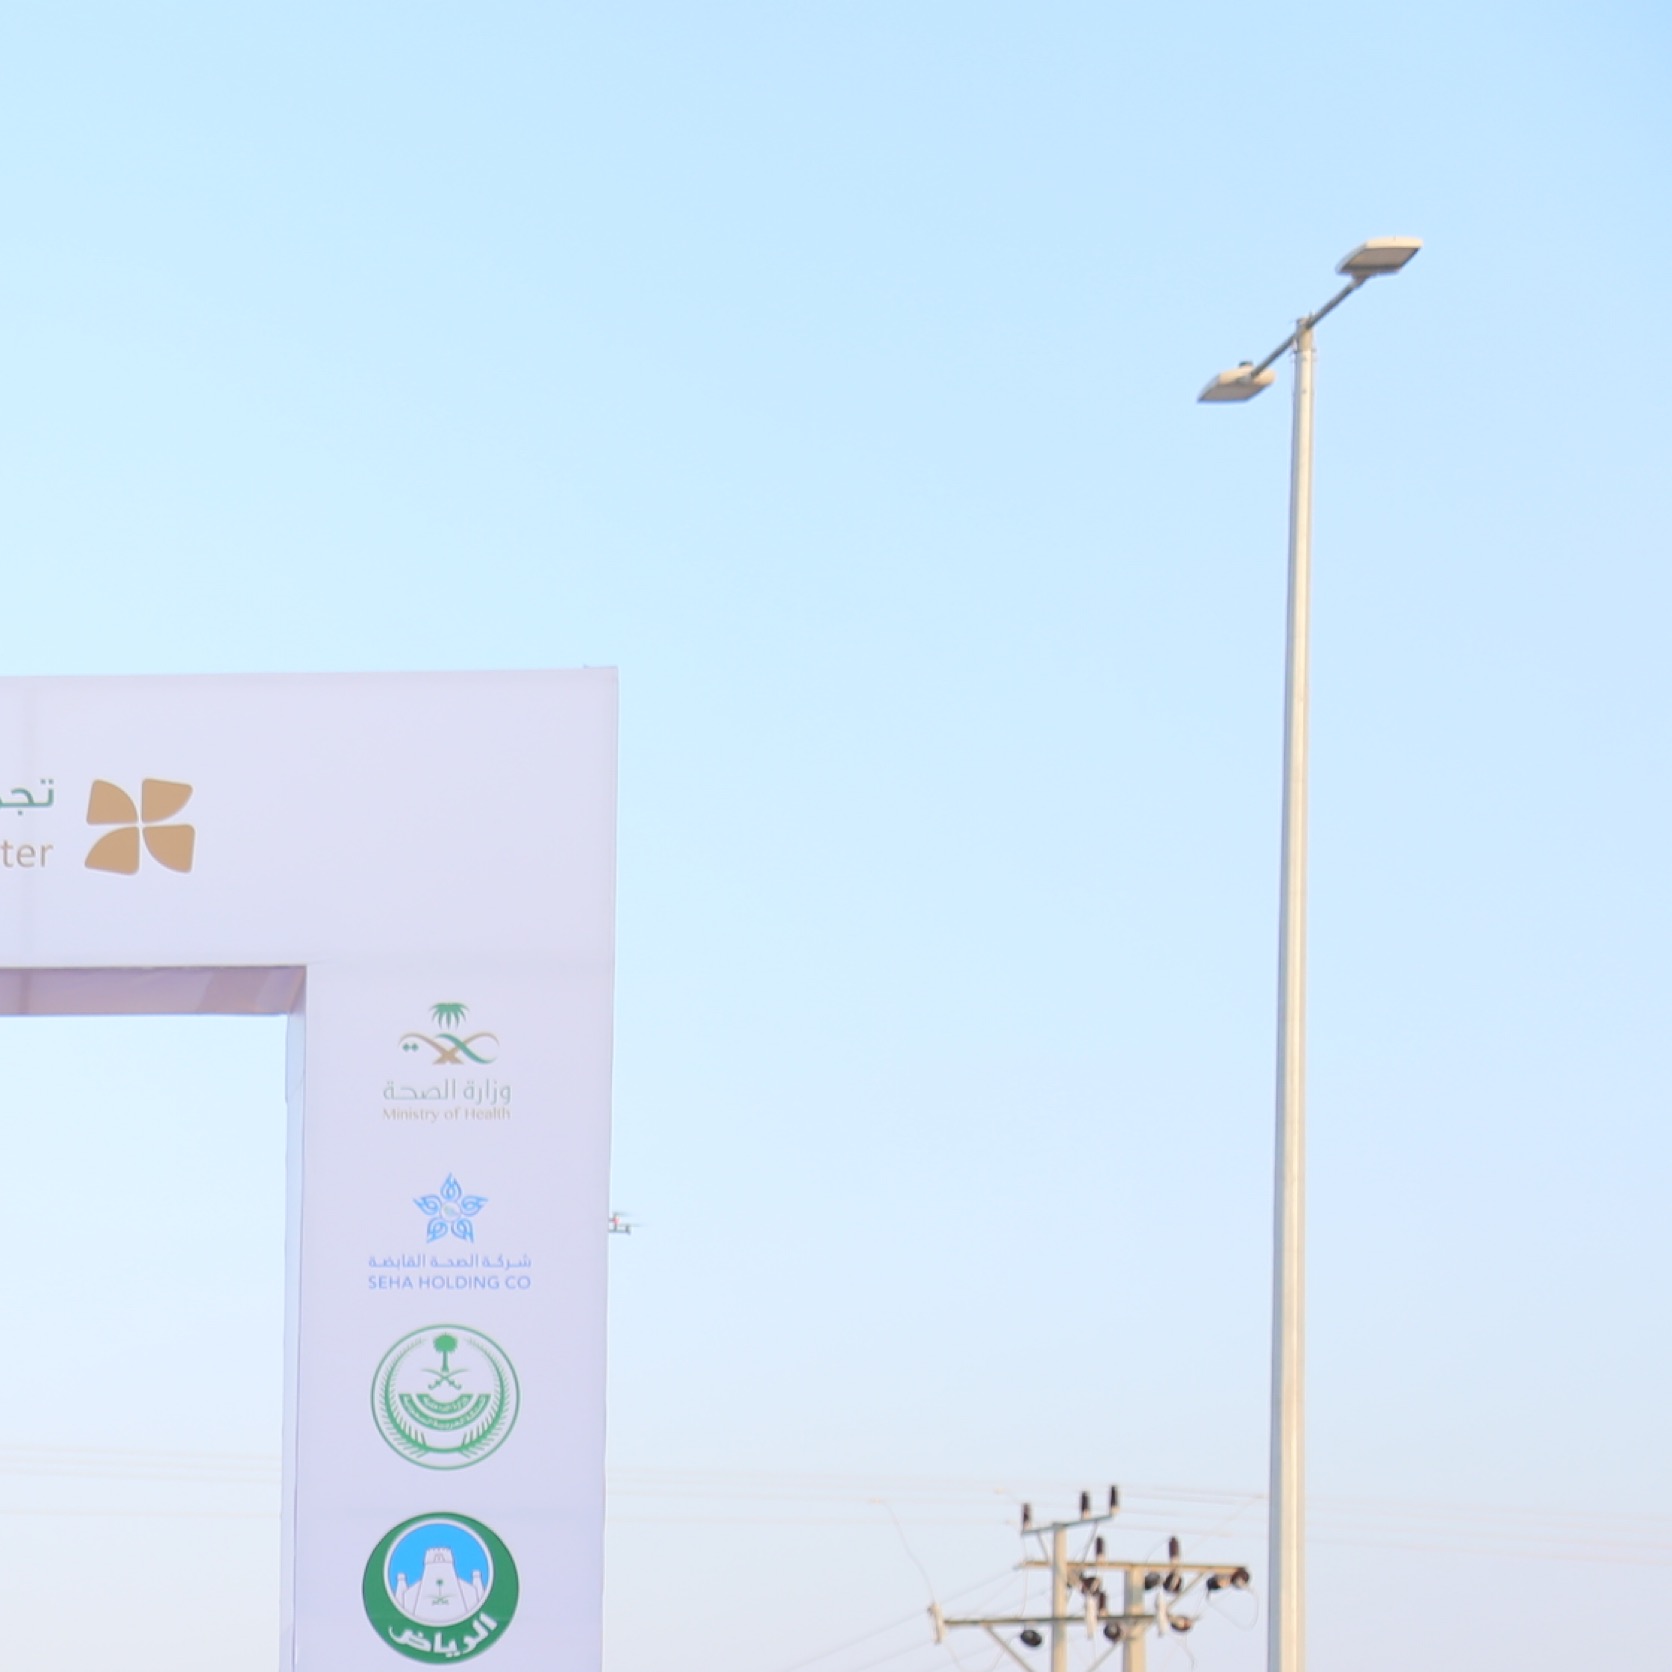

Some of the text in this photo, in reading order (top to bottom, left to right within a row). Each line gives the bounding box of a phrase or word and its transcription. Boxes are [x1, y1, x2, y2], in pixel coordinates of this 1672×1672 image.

[383, 1079, 512, 1104] وزارة الصحة
[383, 1106, 511, 1123] Ministry of Health
[430, 1254, 479, 1268] الصحة
[481, 1254, 532, 1271] شركة
[368, 1275, 532, 1290] SEHA HOLDING CO
[387, 1611, 499, 1659] الرياض
